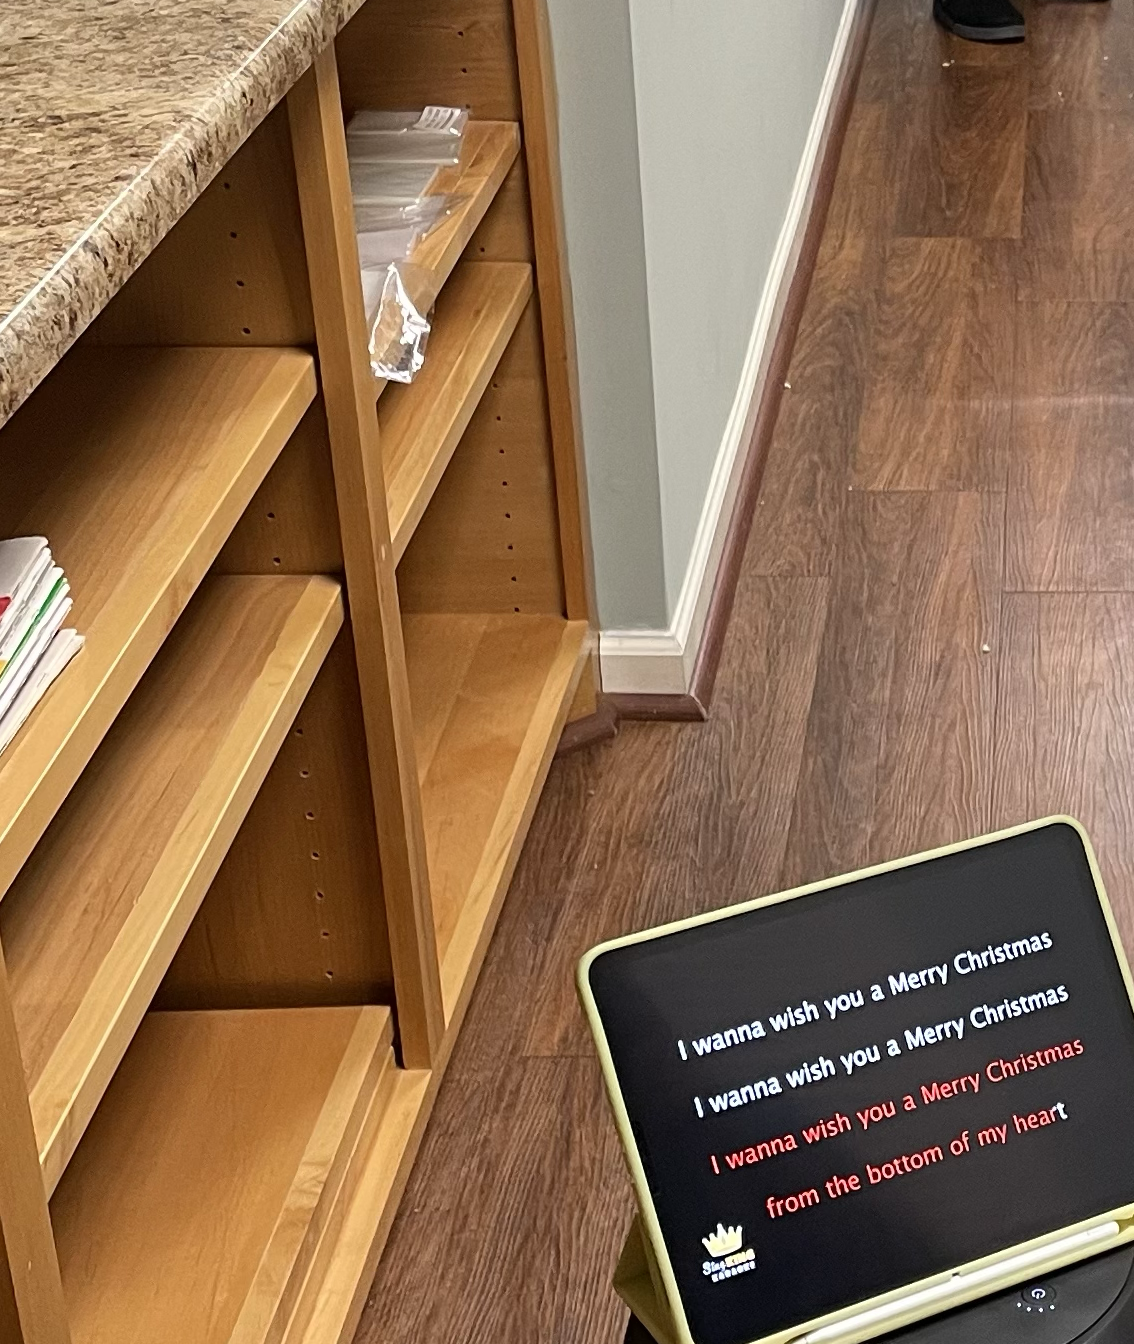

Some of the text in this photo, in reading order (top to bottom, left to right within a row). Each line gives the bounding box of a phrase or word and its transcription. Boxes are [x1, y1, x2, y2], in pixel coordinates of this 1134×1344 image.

[677, 931, 1054, 1062] I wanna wish you a Merry Christmas
[693, 984, 1070, 1119] I wanna wish you a Merry Christmas
[709, 1037, 1085, 1176] I wanna wish you a Merry Christmas
[765, 1101, 1070, 1219] from the bottom of my heart
